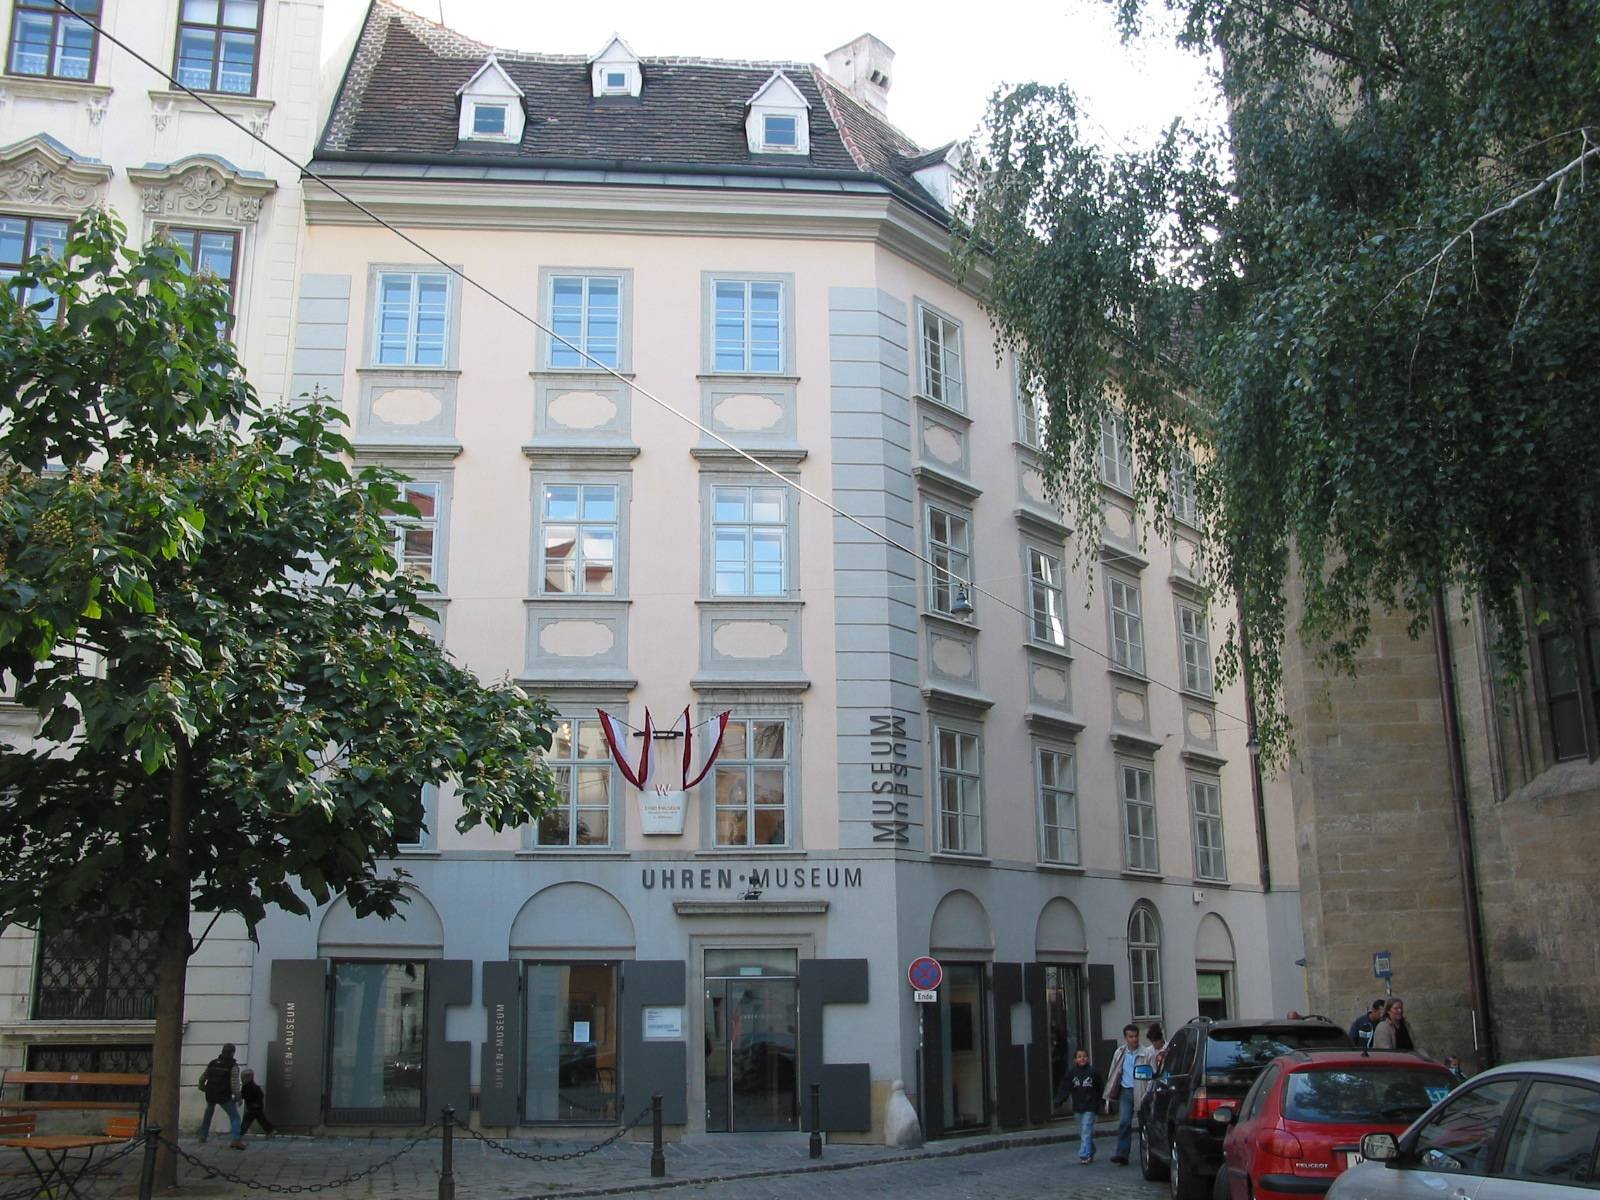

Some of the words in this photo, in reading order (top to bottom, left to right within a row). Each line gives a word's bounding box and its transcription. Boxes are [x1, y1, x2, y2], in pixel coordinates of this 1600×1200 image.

[869, 715, 895, 843] MUSEUM
[891, 715, 909, 843] MUSEUM
[917, 992, 934, 1001] Ende
